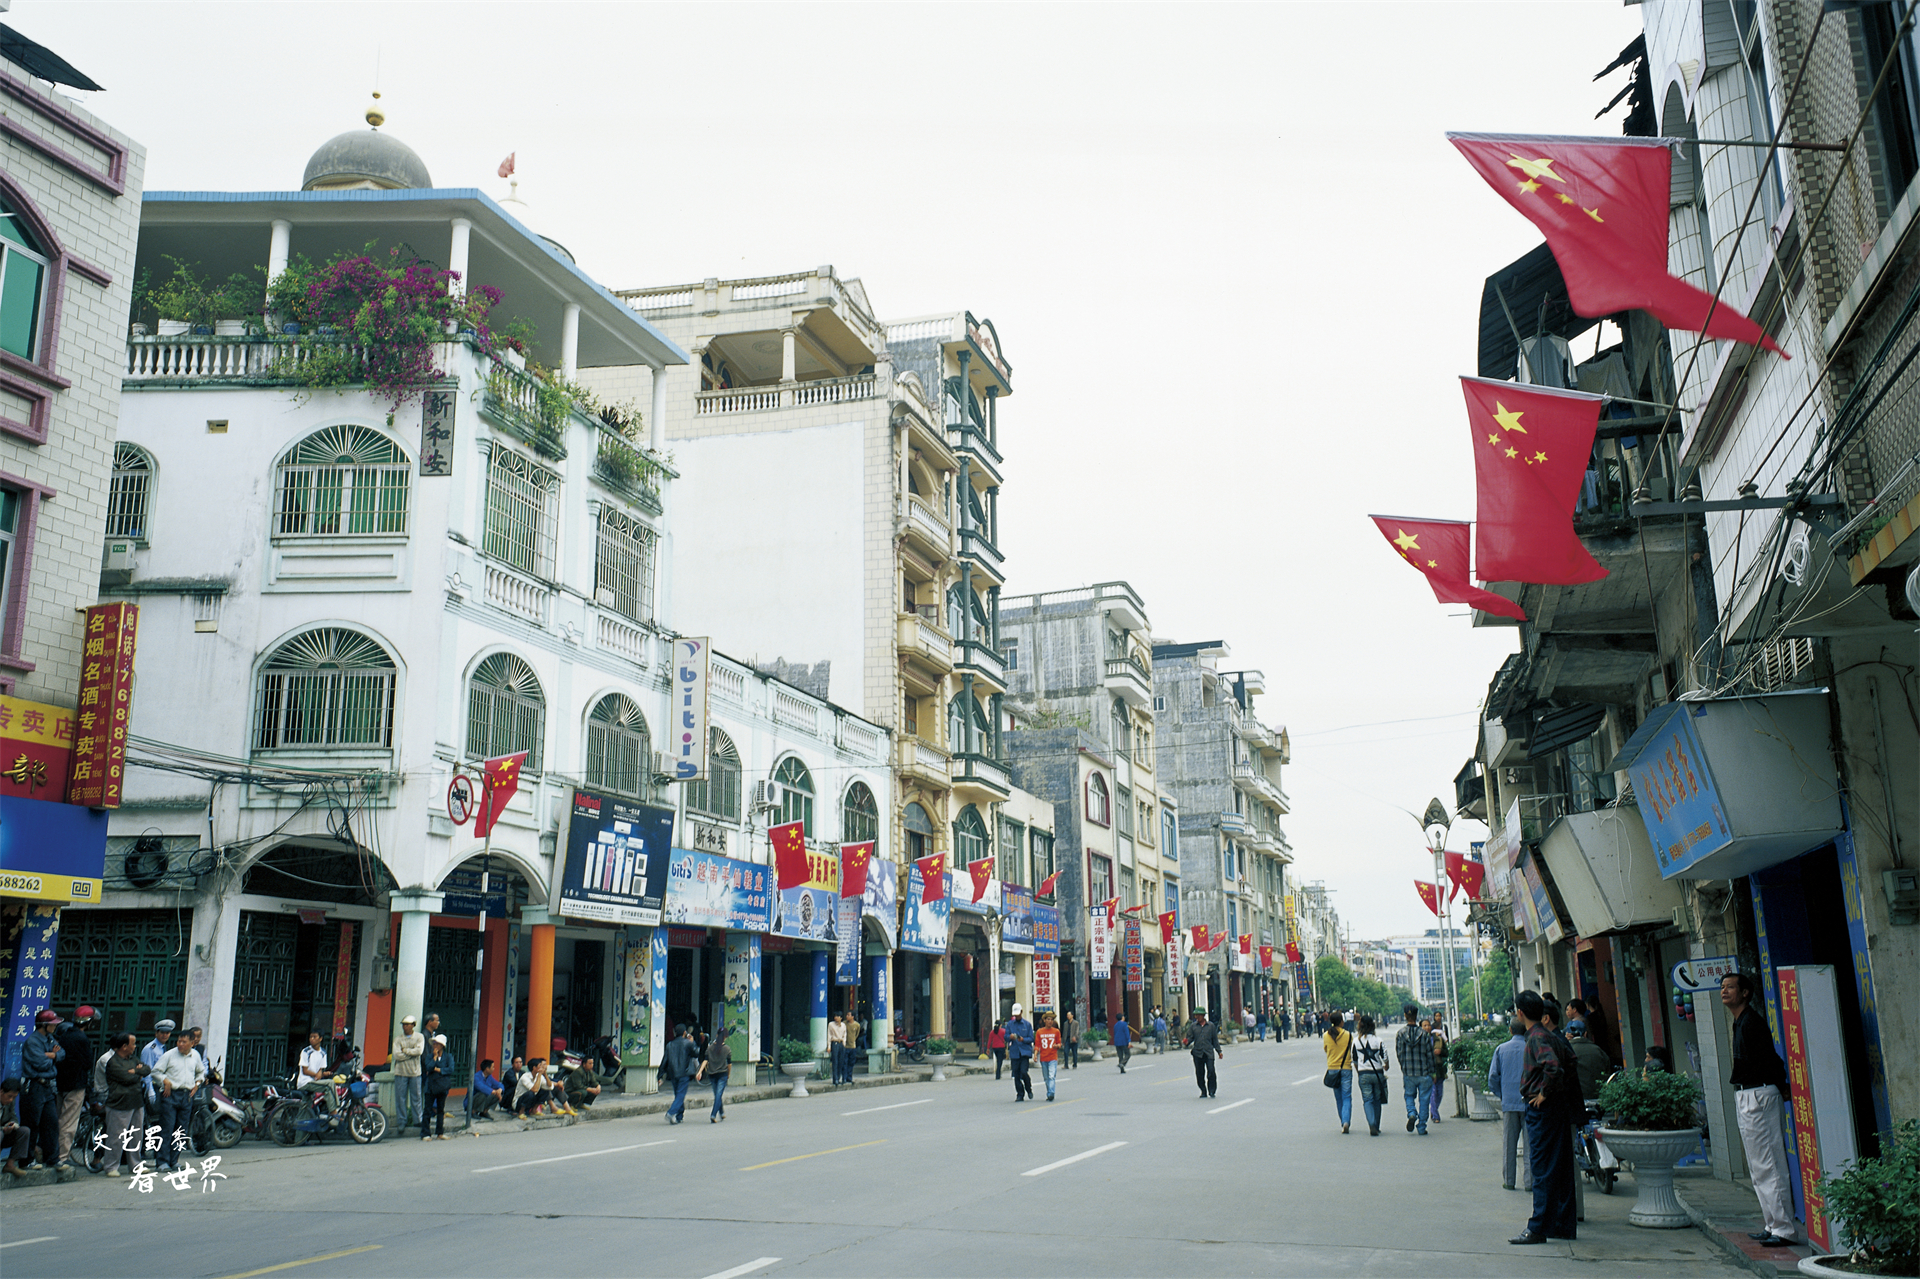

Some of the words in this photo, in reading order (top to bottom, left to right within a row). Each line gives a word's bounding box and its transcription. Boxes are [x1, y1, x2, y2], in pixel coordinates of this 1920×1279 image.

[424, 393, 452, 473] 新和安
[73, 613, 106, 781] 名烟名酒专卖店
[1, 753, 48, 794] 部
[695, 826, 727, 852] 新和安
[697, 861, 764, 892] 越南平仙鞋业
[1094, 917, 1105, 964] 正宗缅甸玉
[33, 946, 53, 1034] 卓越的品
[1035, 961, 1051, 1005] 缅甸翡翠玉
[1697, 964, 1733, 978] 公用电话
[1780, 979, 1799, 1012] 正宗
[1041, 1037, 1055, 1050] 87
